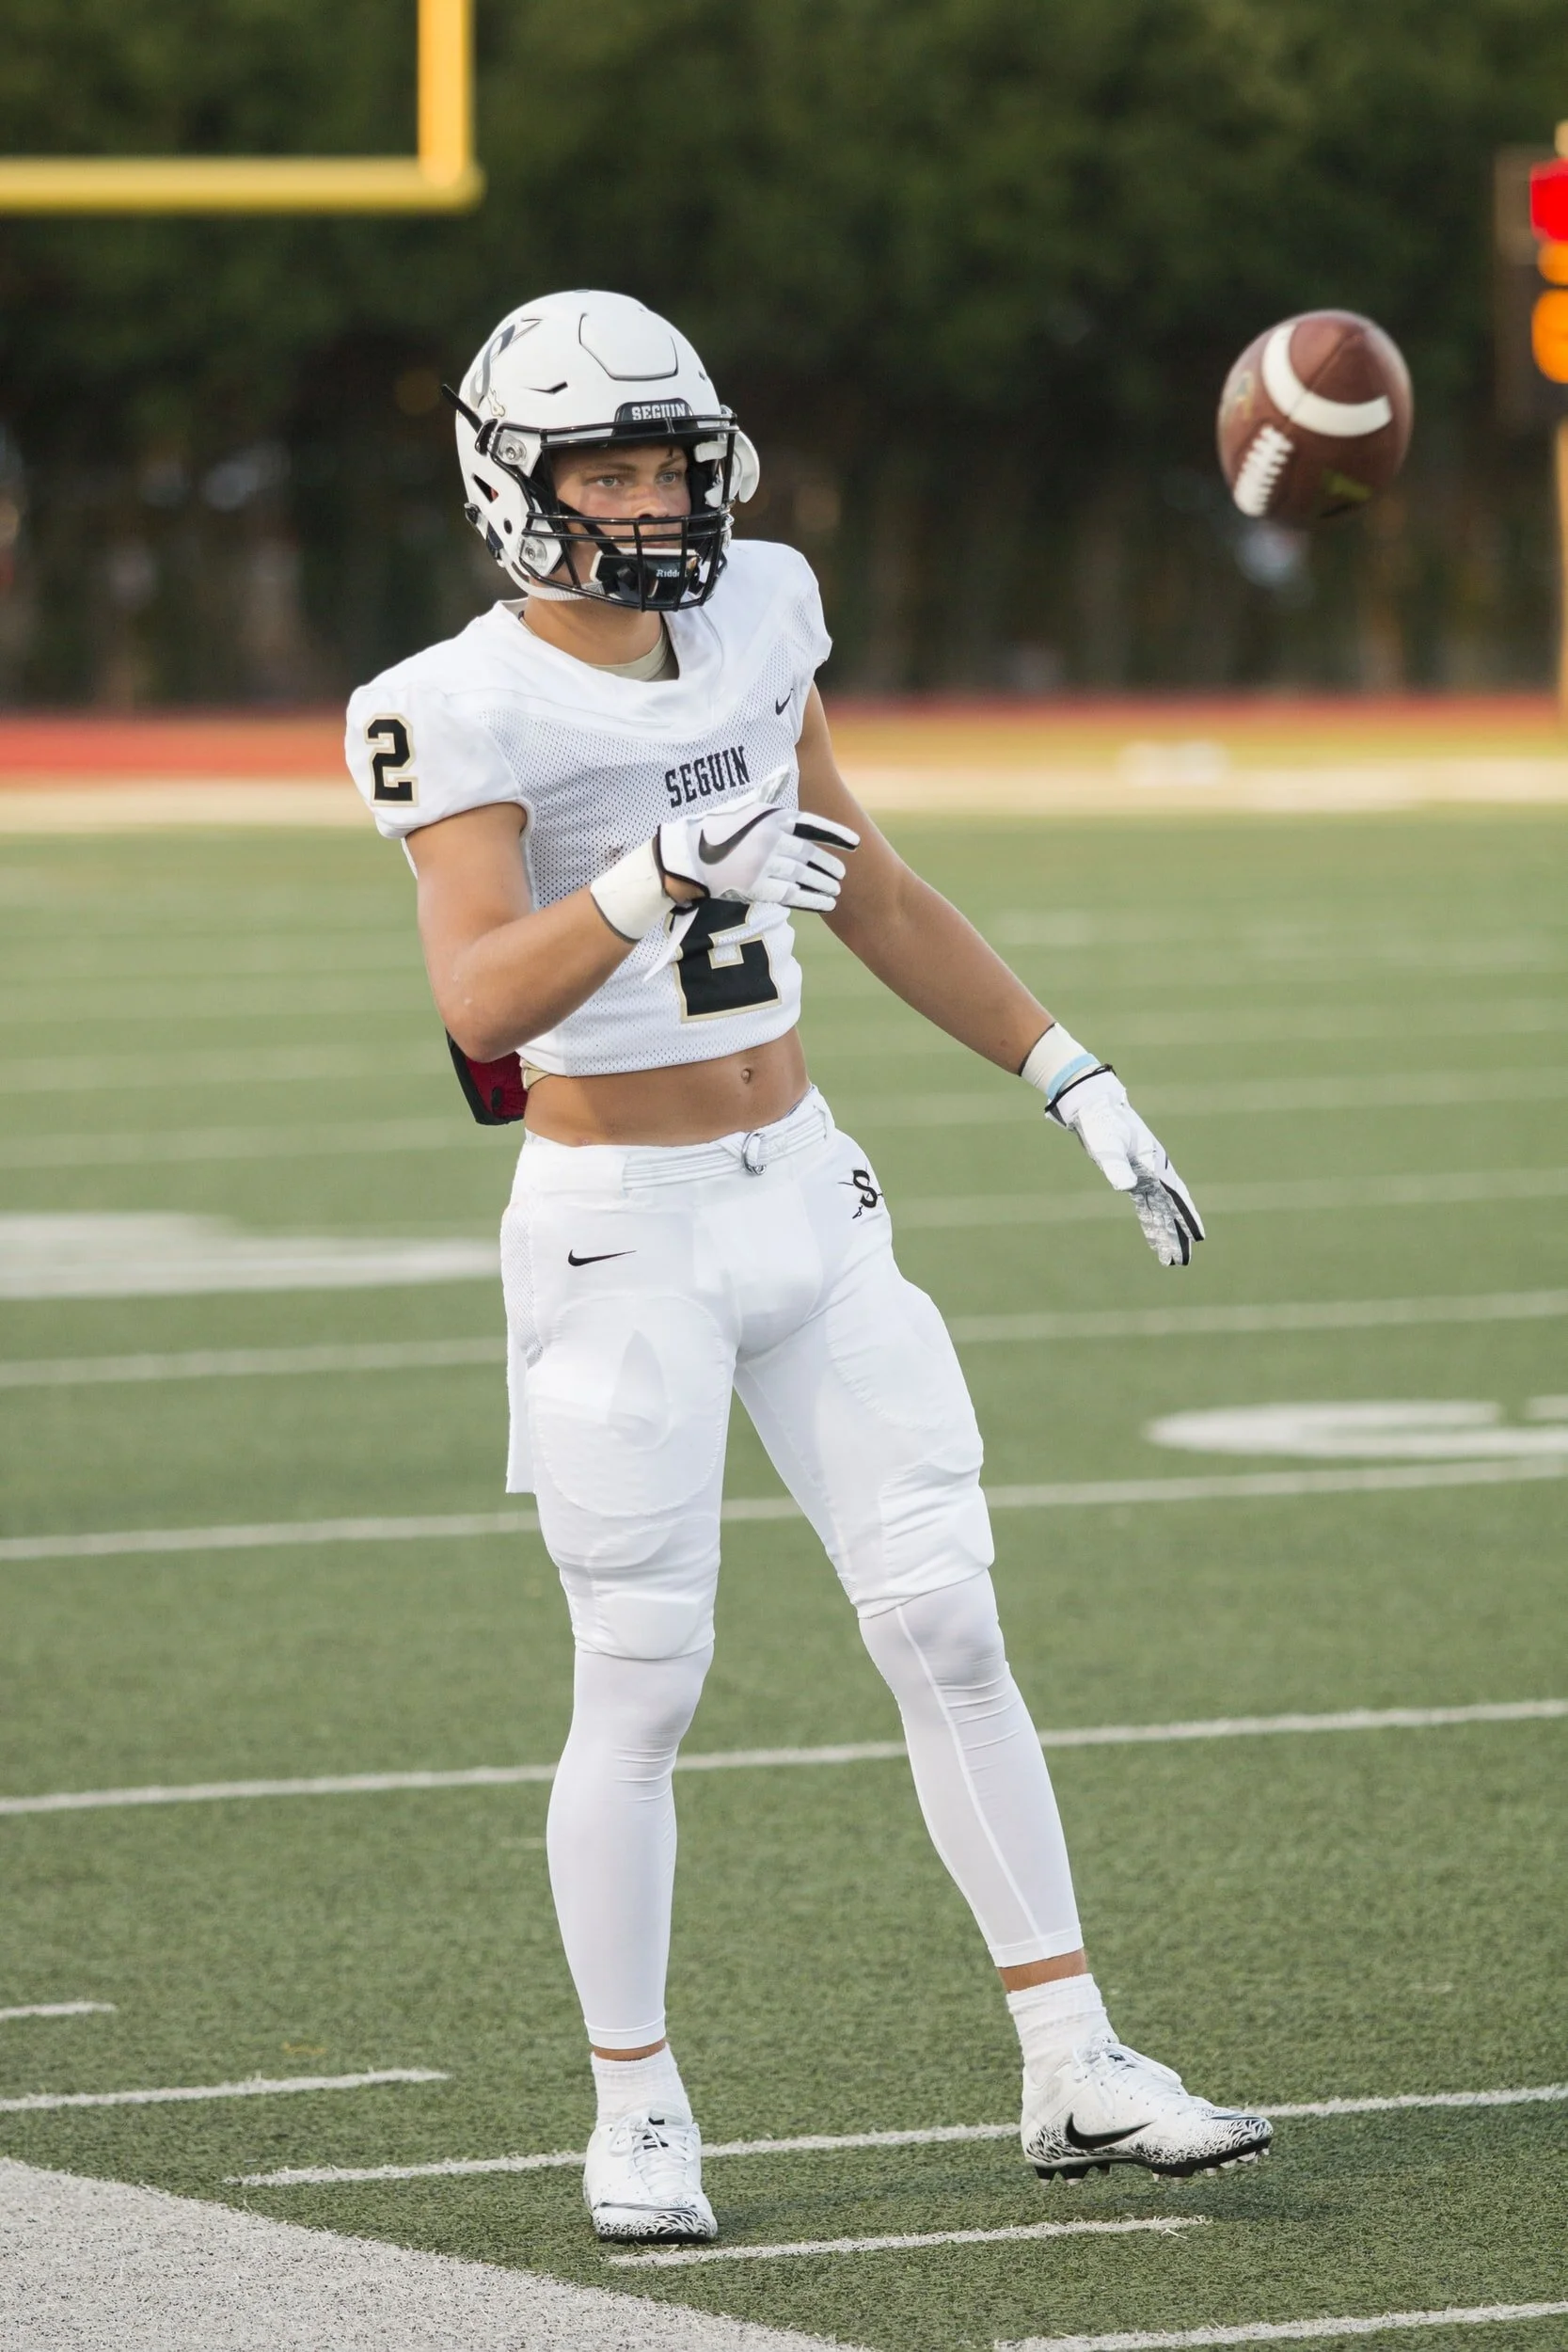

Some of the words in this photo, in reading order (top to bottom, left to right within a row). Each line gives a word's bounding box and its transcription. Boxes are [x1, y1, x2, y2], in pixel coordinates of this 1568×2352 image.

[631, 404, 686, 421] SEGUIN
[657, 569, 689, 579] Ridd
[364, 713, 420, 807] 2
[664, 745, 751, 808] SEGUIN
[663, 898, 782, 1024] 2
